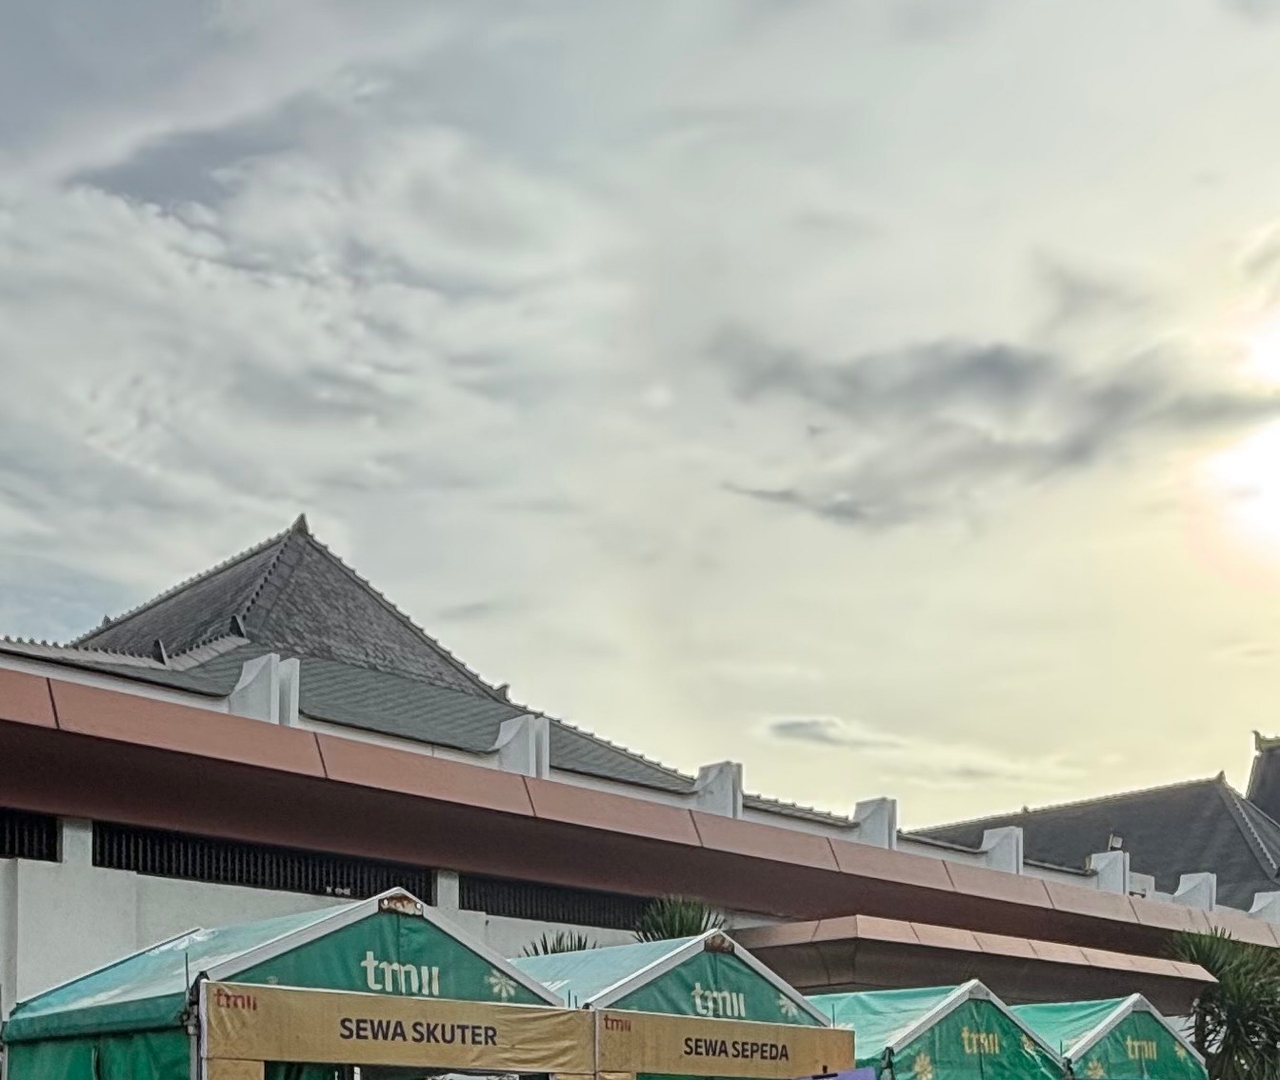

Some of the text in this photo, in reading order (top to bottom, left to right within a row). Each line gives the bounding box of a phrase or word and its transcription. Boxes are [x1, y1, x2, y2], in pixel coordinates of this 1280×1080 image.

[360, 950, 440, 996] tmii
[339, 1017, 498, 1046] SEWA SKUTER
[683, 1037, 790, 1061] SEWA SEPEDA
